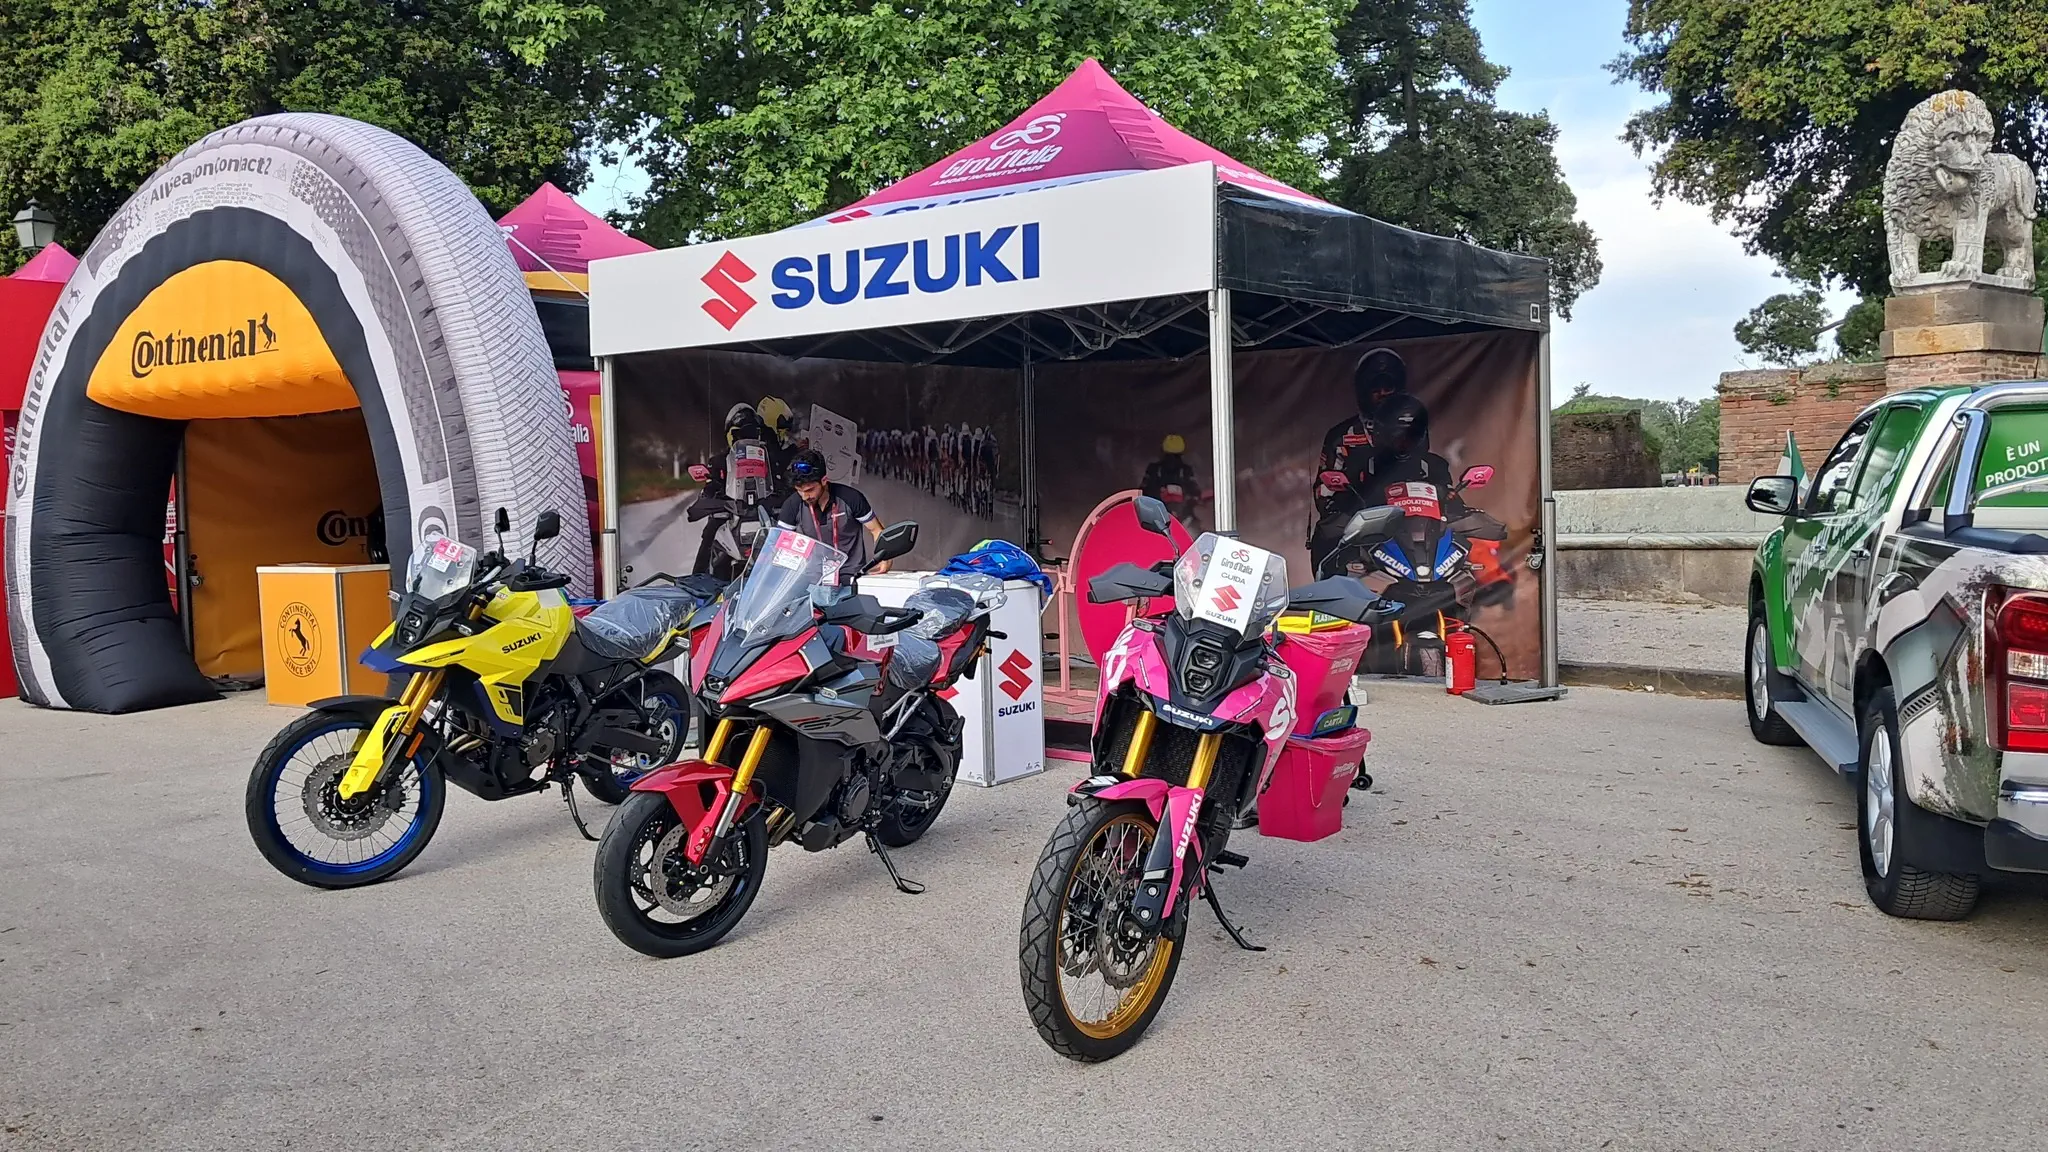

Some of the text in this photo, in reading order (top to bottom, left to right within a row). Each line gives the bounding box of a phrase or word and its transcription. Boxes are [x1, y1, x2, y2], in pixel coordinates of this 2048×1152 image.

[771, 222, 1040, 310] SUZUKI
[131, 319, 257, 379] Continental
[14, 304, 70, 498] Continental
[2006, 440, 2041, 462] È UN
[1221, 557, 1234, 569] Giro
[1374, 549, 1412, 576] SUZUKI
[1436, 549, 1463, 576] SUZUKI
[1221, 572, 1246, 585] GUIDA
[280, 604, 317, 629] CONTINENTAL
[1205, 609, 1237, 625] SUZUKI
[501, 632, 542, 654] SUZUKI
[286, 657, 317, 675] SINCE 1871
[998, 701, 1036, 717] SUZUKI
[1162, 704, 1213, 727] SUZUKI
[1175, 793, 1203, 860] SUZUKI
